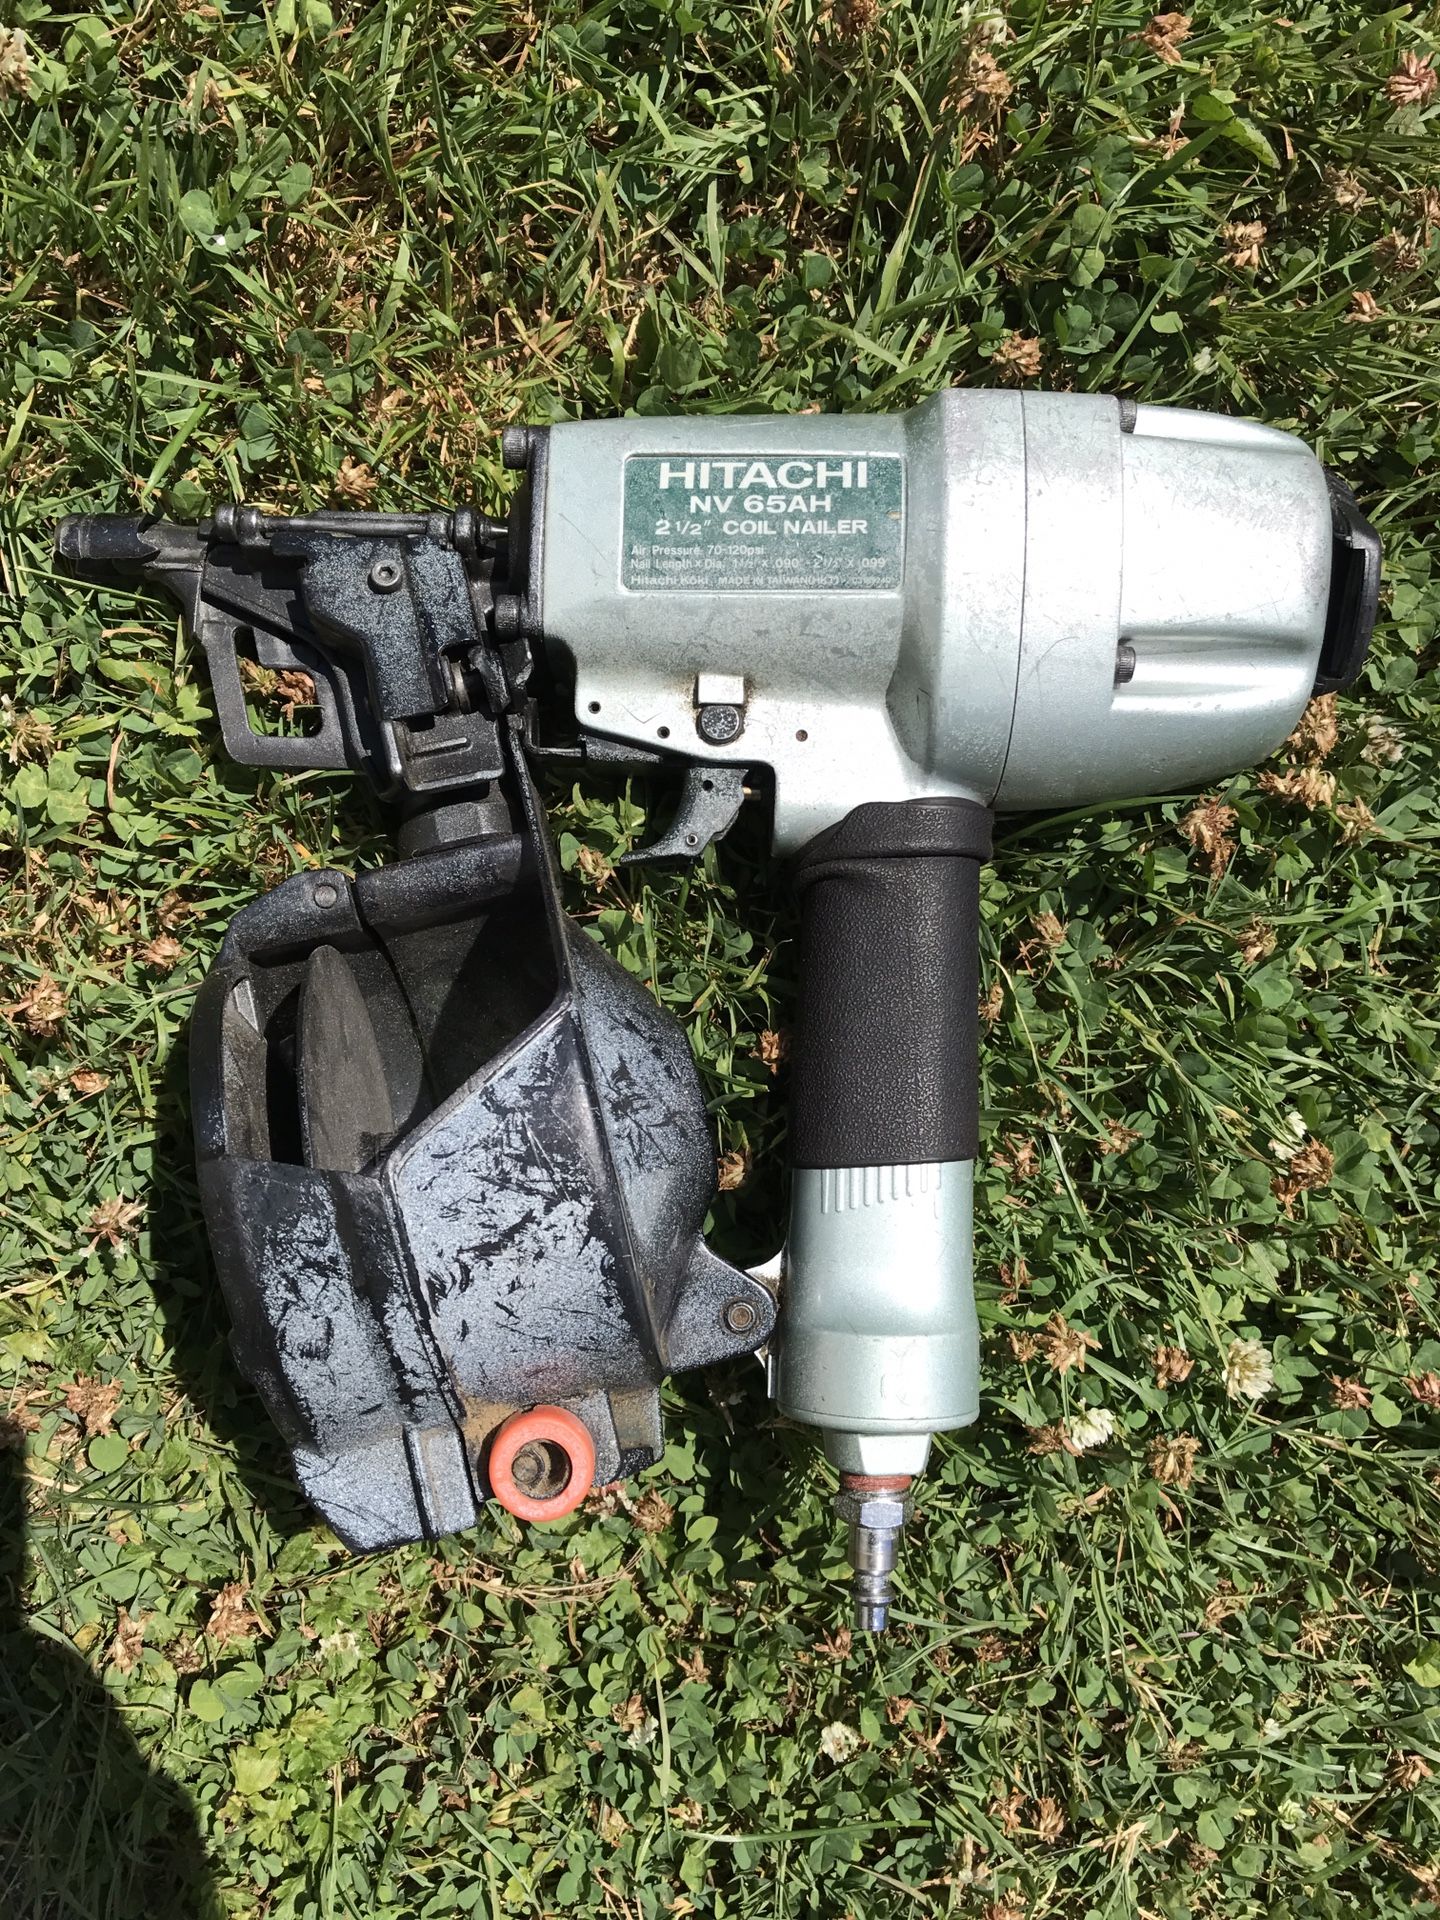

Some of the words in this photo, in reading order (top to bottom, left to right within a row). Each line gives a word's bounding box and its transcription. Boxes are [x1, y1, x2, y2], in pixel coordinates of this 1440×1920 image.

[659, 461, 868, 489] HITACHI
[690, 495, 738, 513] NV
[743, 495, 832, 514] 65AH
[722, 519, 777, 535] COIL
[783, 519, 868, 535] NAILER
[631, 545, 647, 556] Air
[707, 545, 765, 557] 70-120psi
[630, 558, 651, 569] Nail
[655, 558, 692, 571] Length
[630, 575, 678, 586] Hitachi
[680, 575, 709, 586] Koki
[718, 575, 750, 586] MADE
[752, 575, 763, 586] IN
